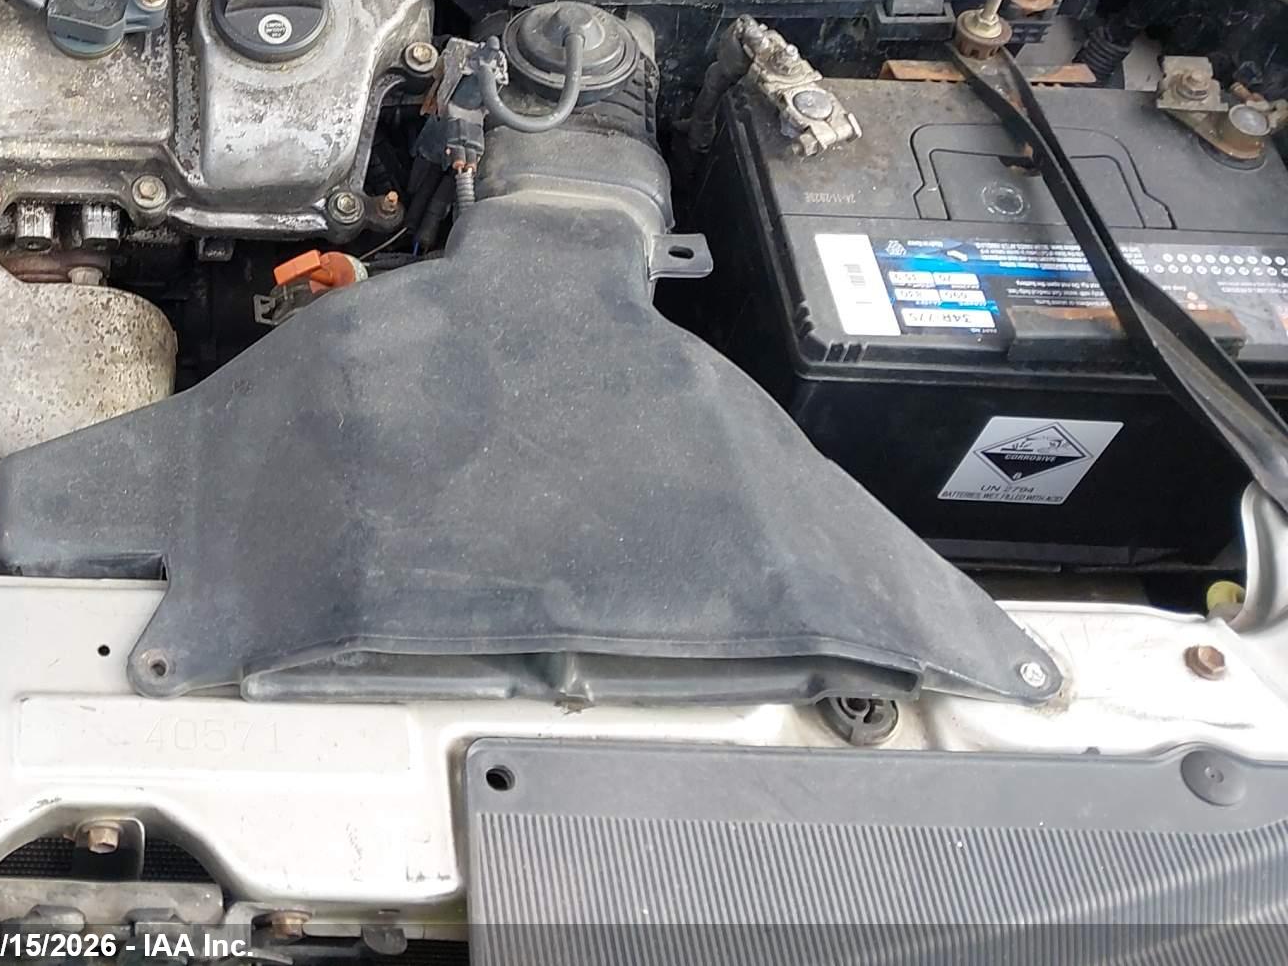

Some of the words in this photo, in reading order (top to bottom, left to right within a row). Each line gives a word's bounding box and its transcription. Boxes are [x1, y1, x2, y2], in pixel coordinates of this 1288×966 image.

[1004, 453, 1057, 462] CORROSIVE
[981, 484, 1001, 492] UN
[1003, 485, 1034, 493] 2794
[145, 718, 284, 755] 40571
